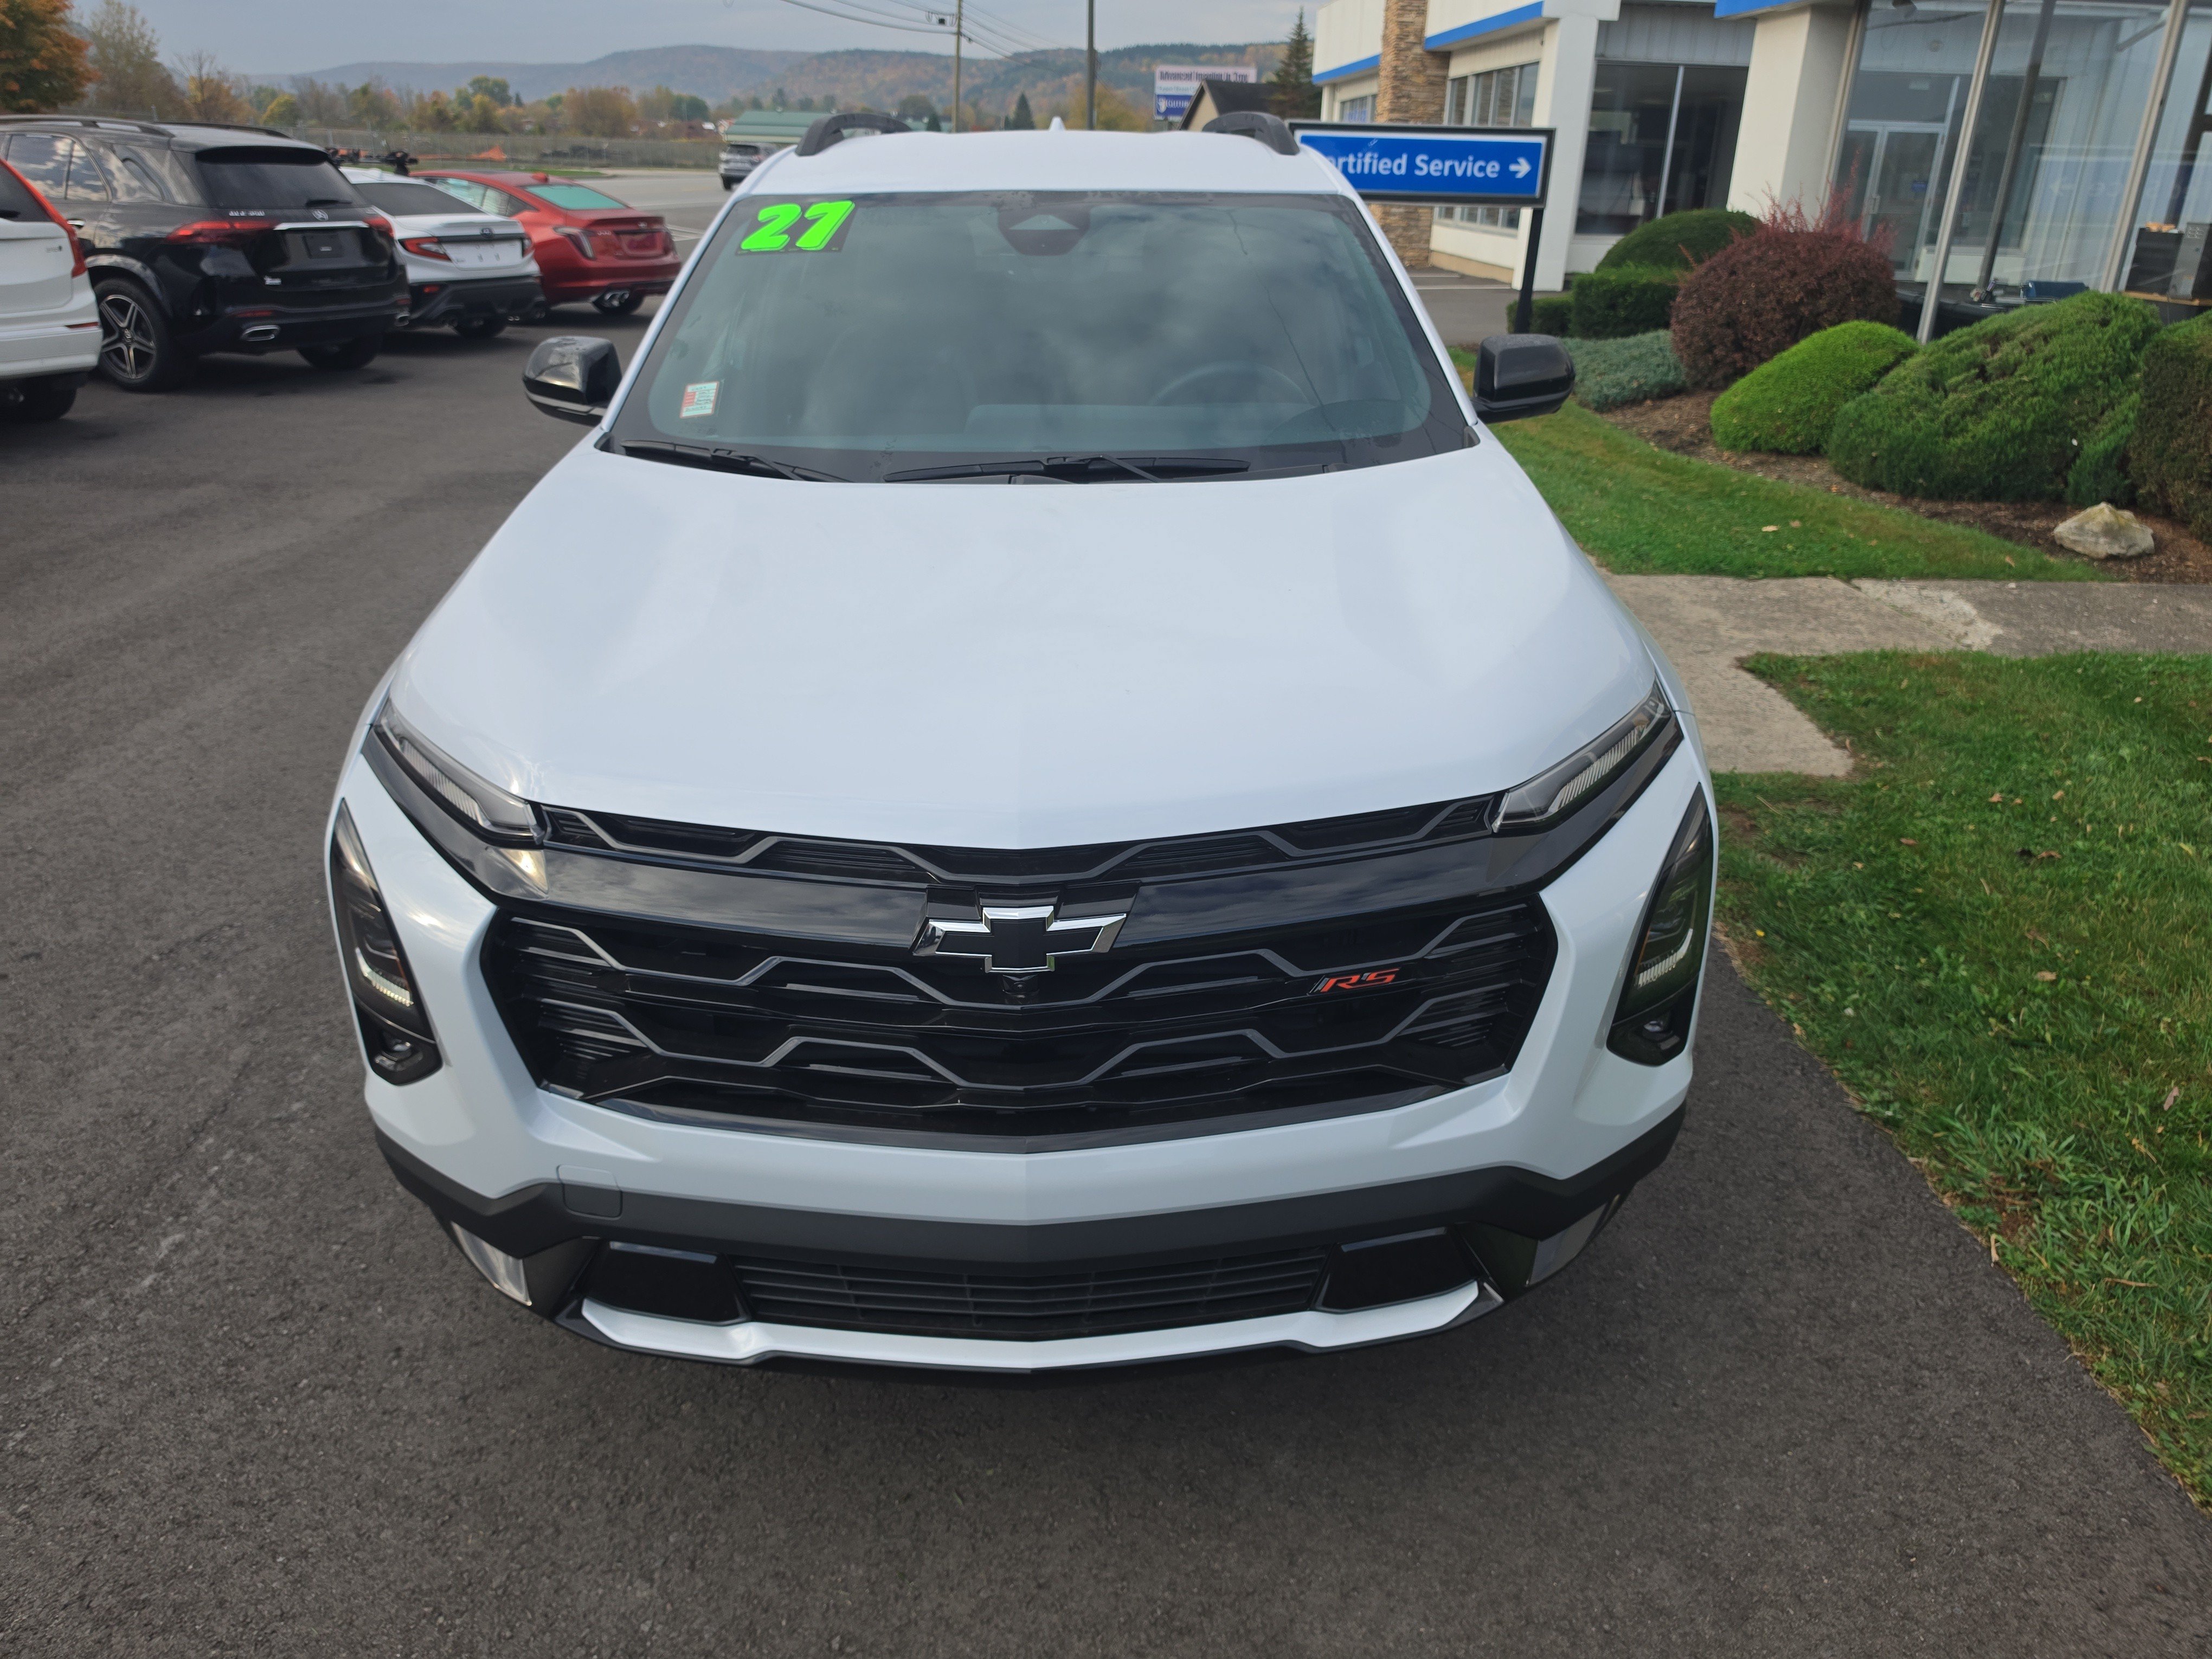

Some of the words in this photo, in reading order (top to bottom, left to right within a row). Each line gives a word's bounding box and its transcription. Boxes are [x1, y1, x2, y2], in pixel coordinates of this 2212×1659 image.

[1327, 152, 1408, 176] rtified
[1414, 153, 1501, 178] Service
[741, 200, 856, 252] 27
[1314, 967, 1400, 993] RS
